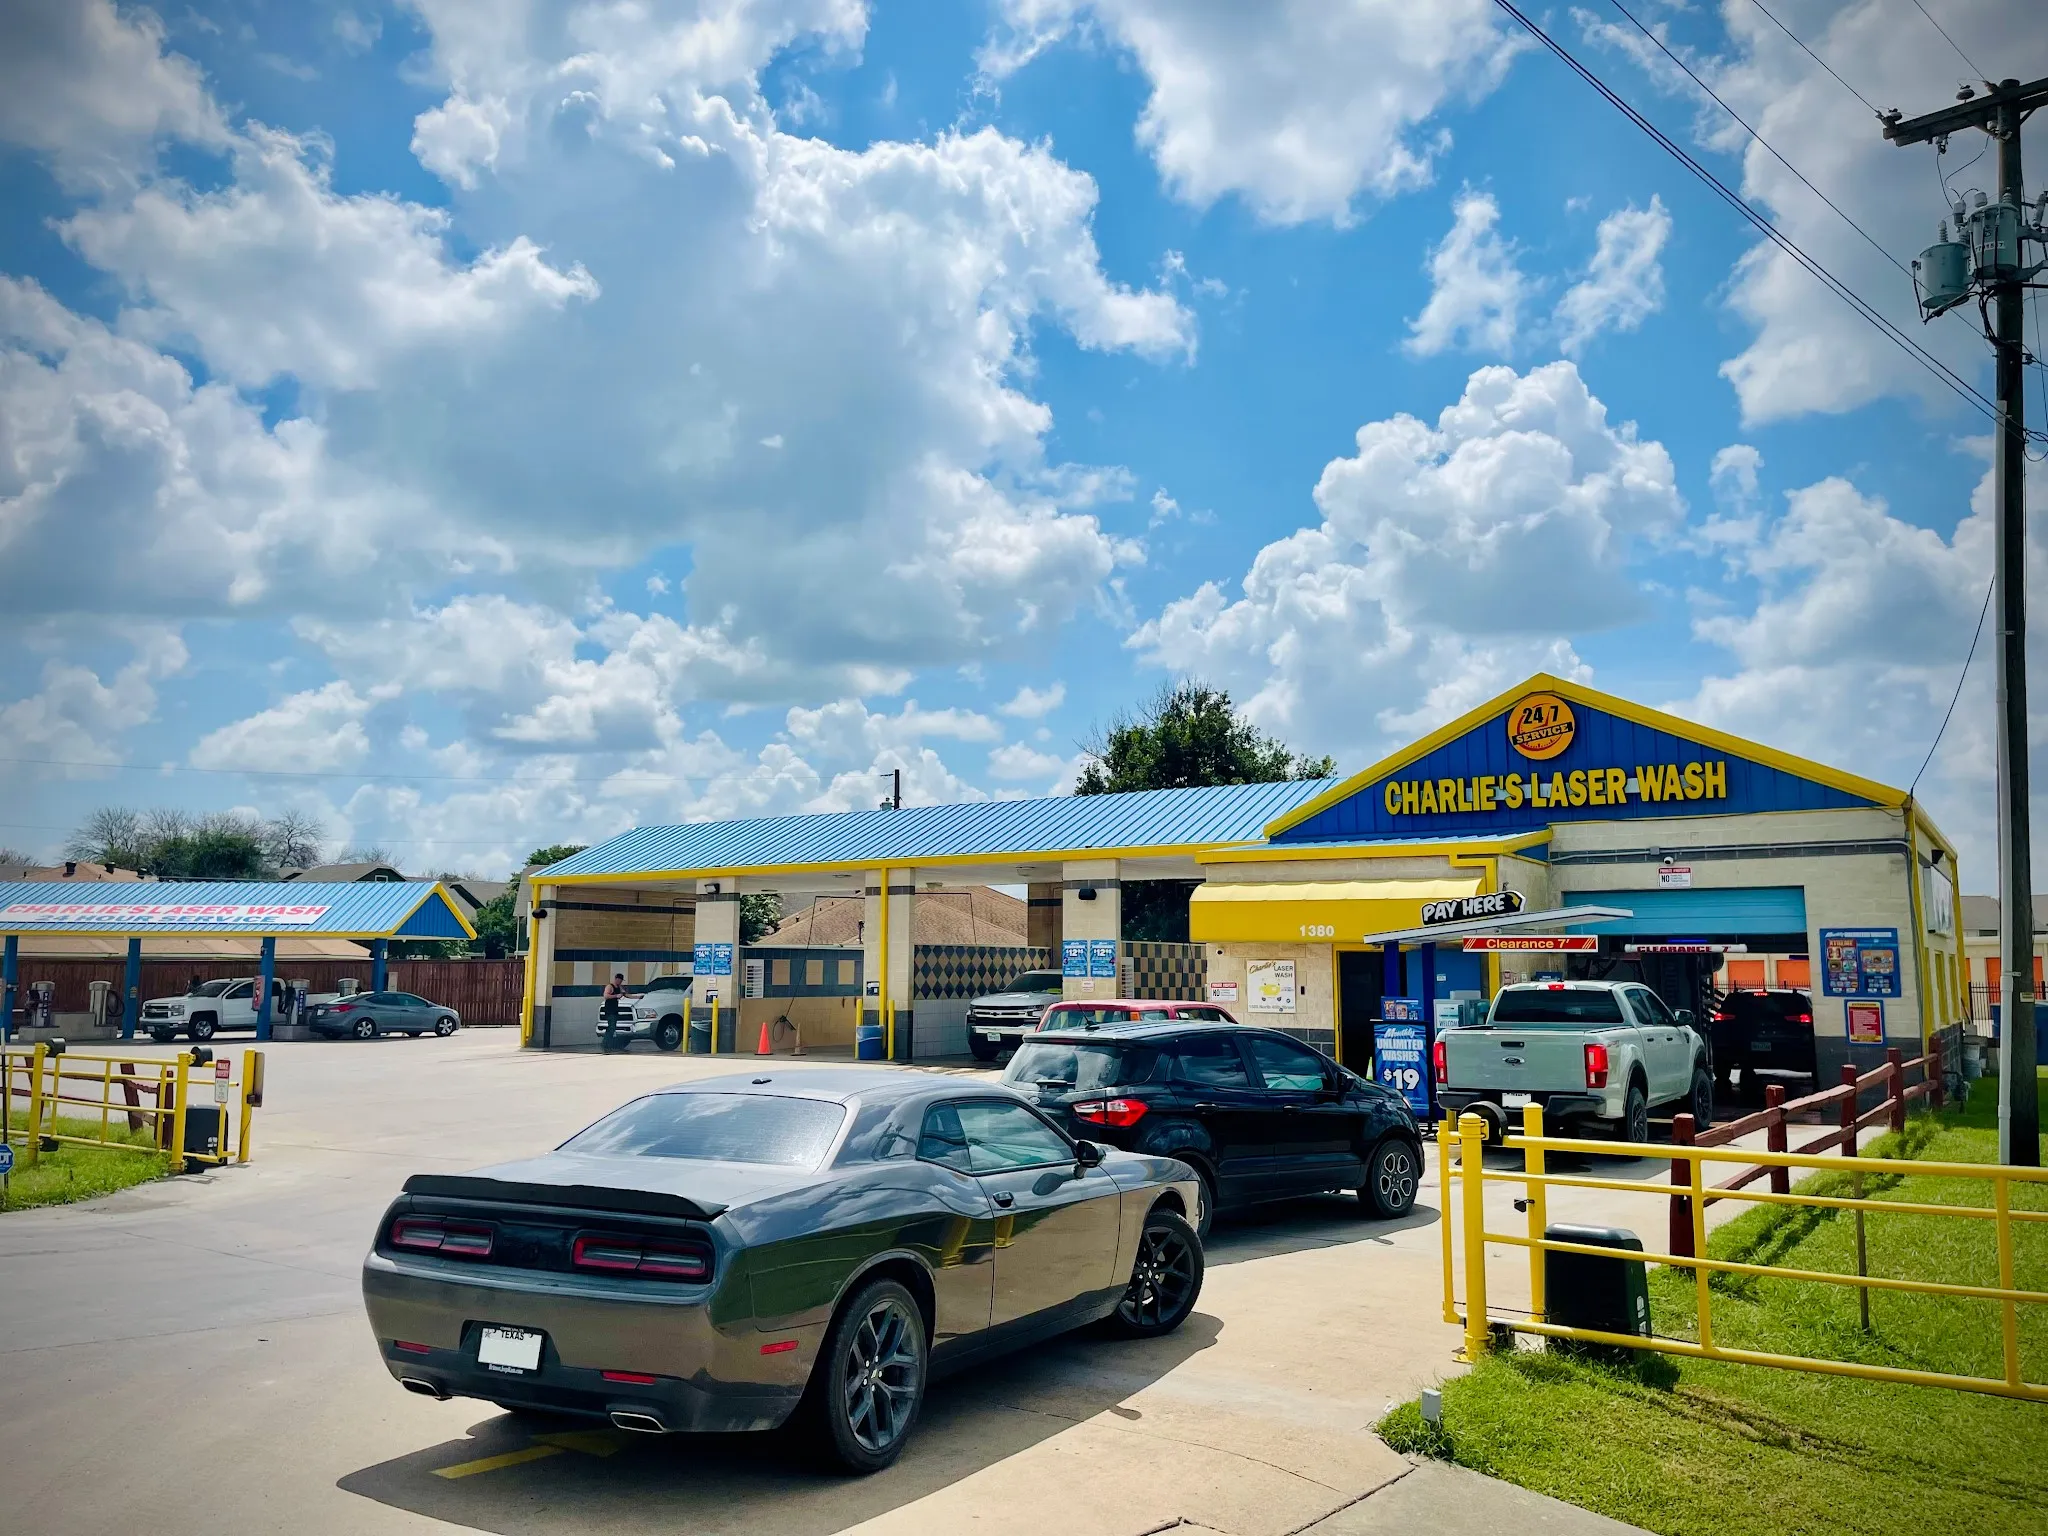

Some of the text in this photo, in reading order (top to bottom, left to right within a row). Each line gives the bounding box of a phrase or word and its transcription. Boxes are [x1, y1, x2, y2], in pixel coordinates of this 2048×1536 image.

[1516, 724, 1569, 745] SERVICE
[1384, 761, 1727, 816] CHARLIE'S LASER WASH
[1661, 874, 1670, 883] NO
[6, 905, 327, 916] CHARLIE'S LASER WASH
[1423, 893, 1506, 923] PAY HERE
[158, 915, 280, 923] SERVICE
[1299, 925, 1335, 937] 1380
[1486, 938, 1555, 950] Clearance
[1384, 1027, 1416, 1039] Monthly
[1376, 1038, 1424, 1051] UNLIMITED
[1381, 1050, 1420, 1062] WASHES
[1383, 1068, 1420, 1090] $19
[0, 1152, 12, 1164] DT
[501, 1330, 524, 1340] TEXAS
